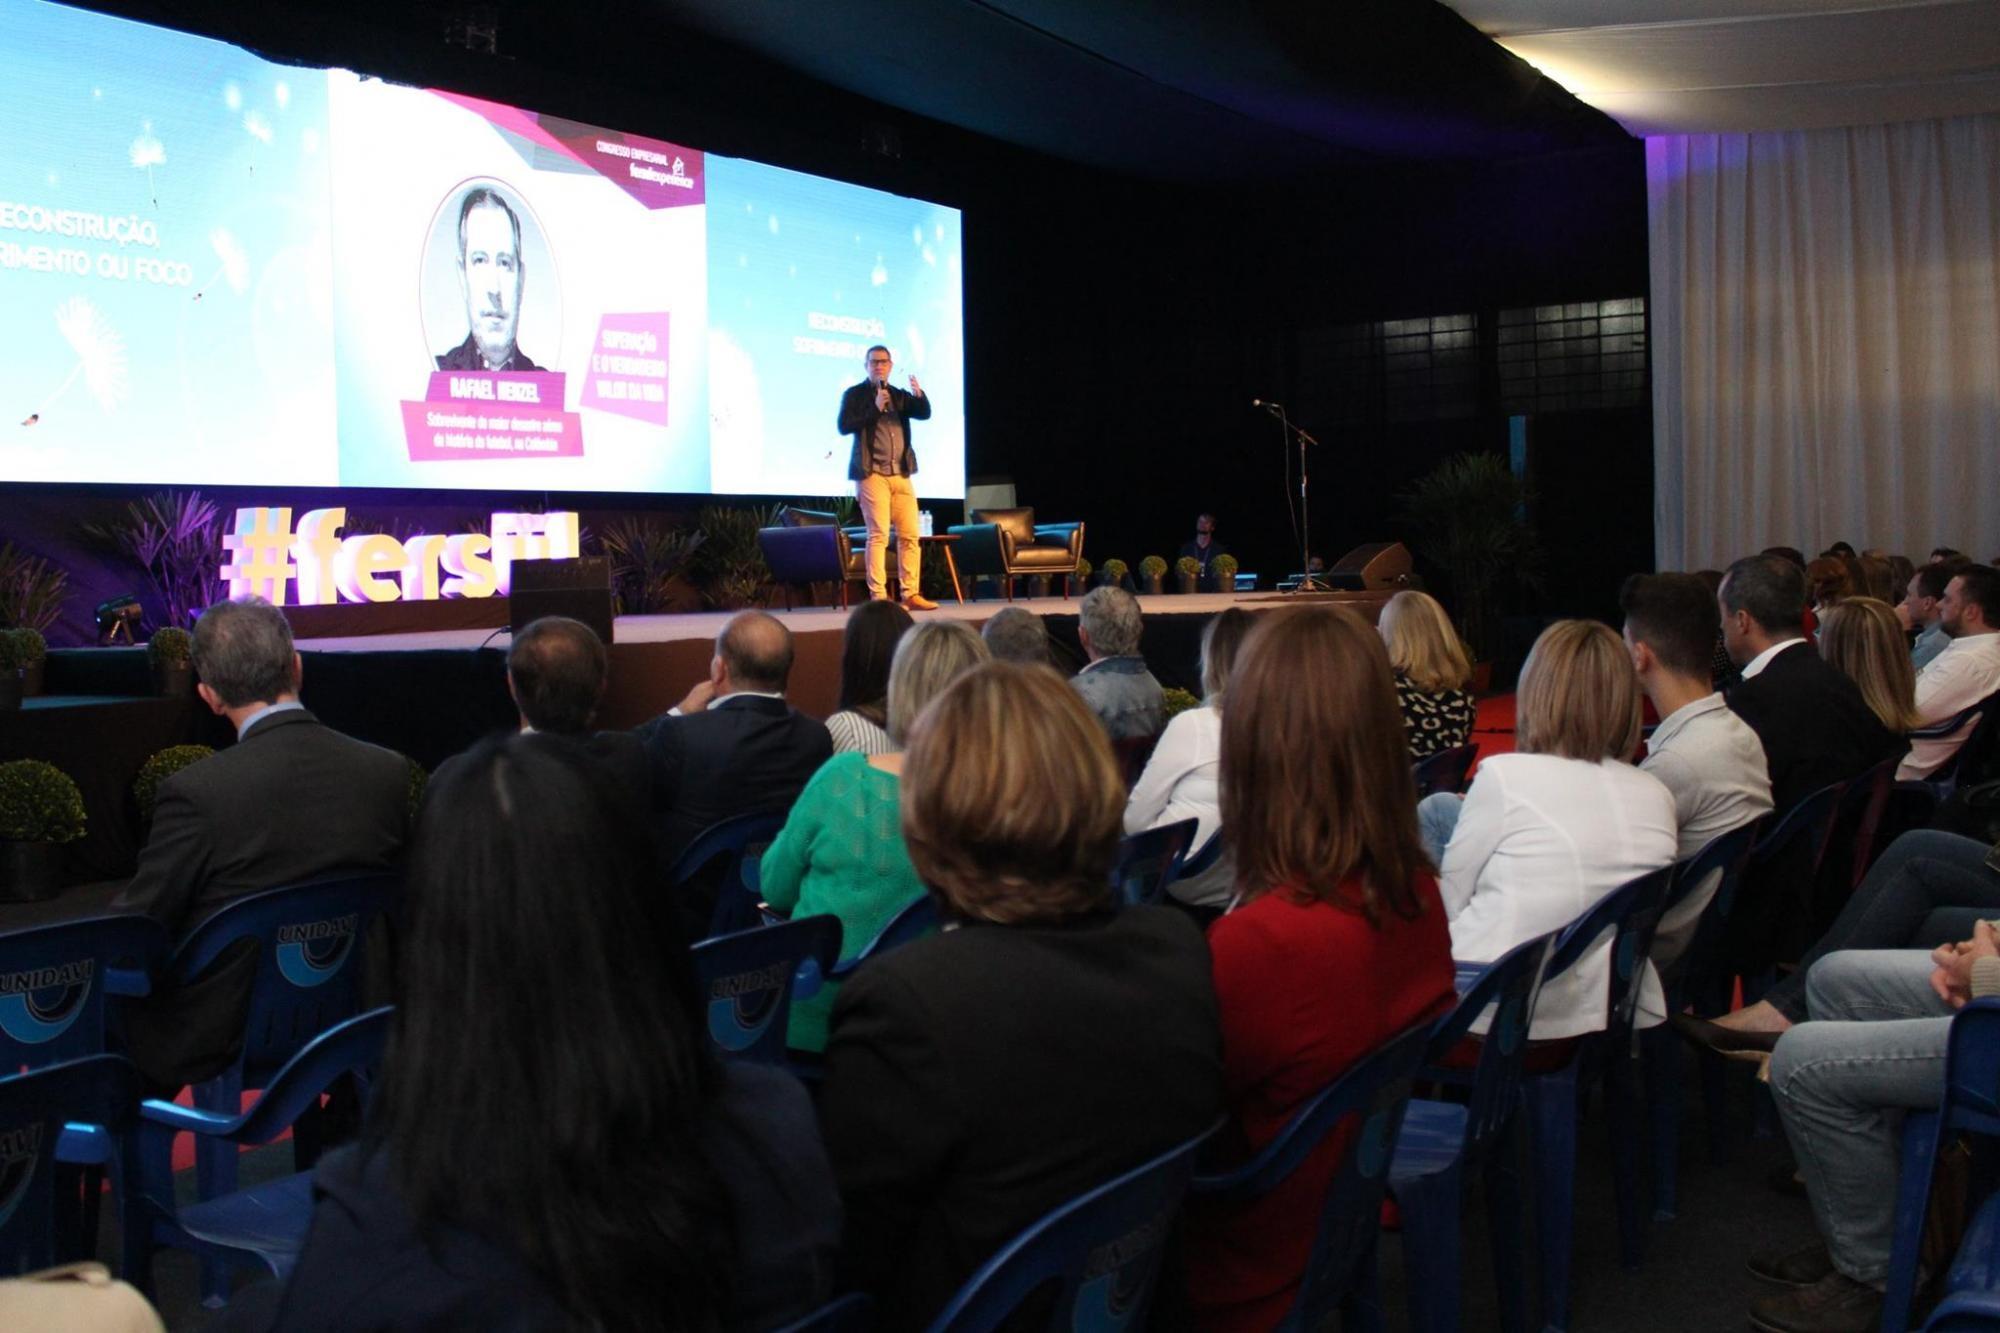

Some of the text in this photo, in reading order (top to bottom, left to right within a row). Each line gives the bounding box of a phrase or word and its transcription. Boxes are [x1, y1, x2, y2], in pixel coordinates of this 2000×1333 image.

[0, 202, 160, 248] ECONSTRUÇÃO,
[96, 252, 129, 280] OU
[135, 257, 193, 287] FOCO
[450, 377, 495, 399] RAFAEL
[0, 958, 96, 993] UNIDAVI
